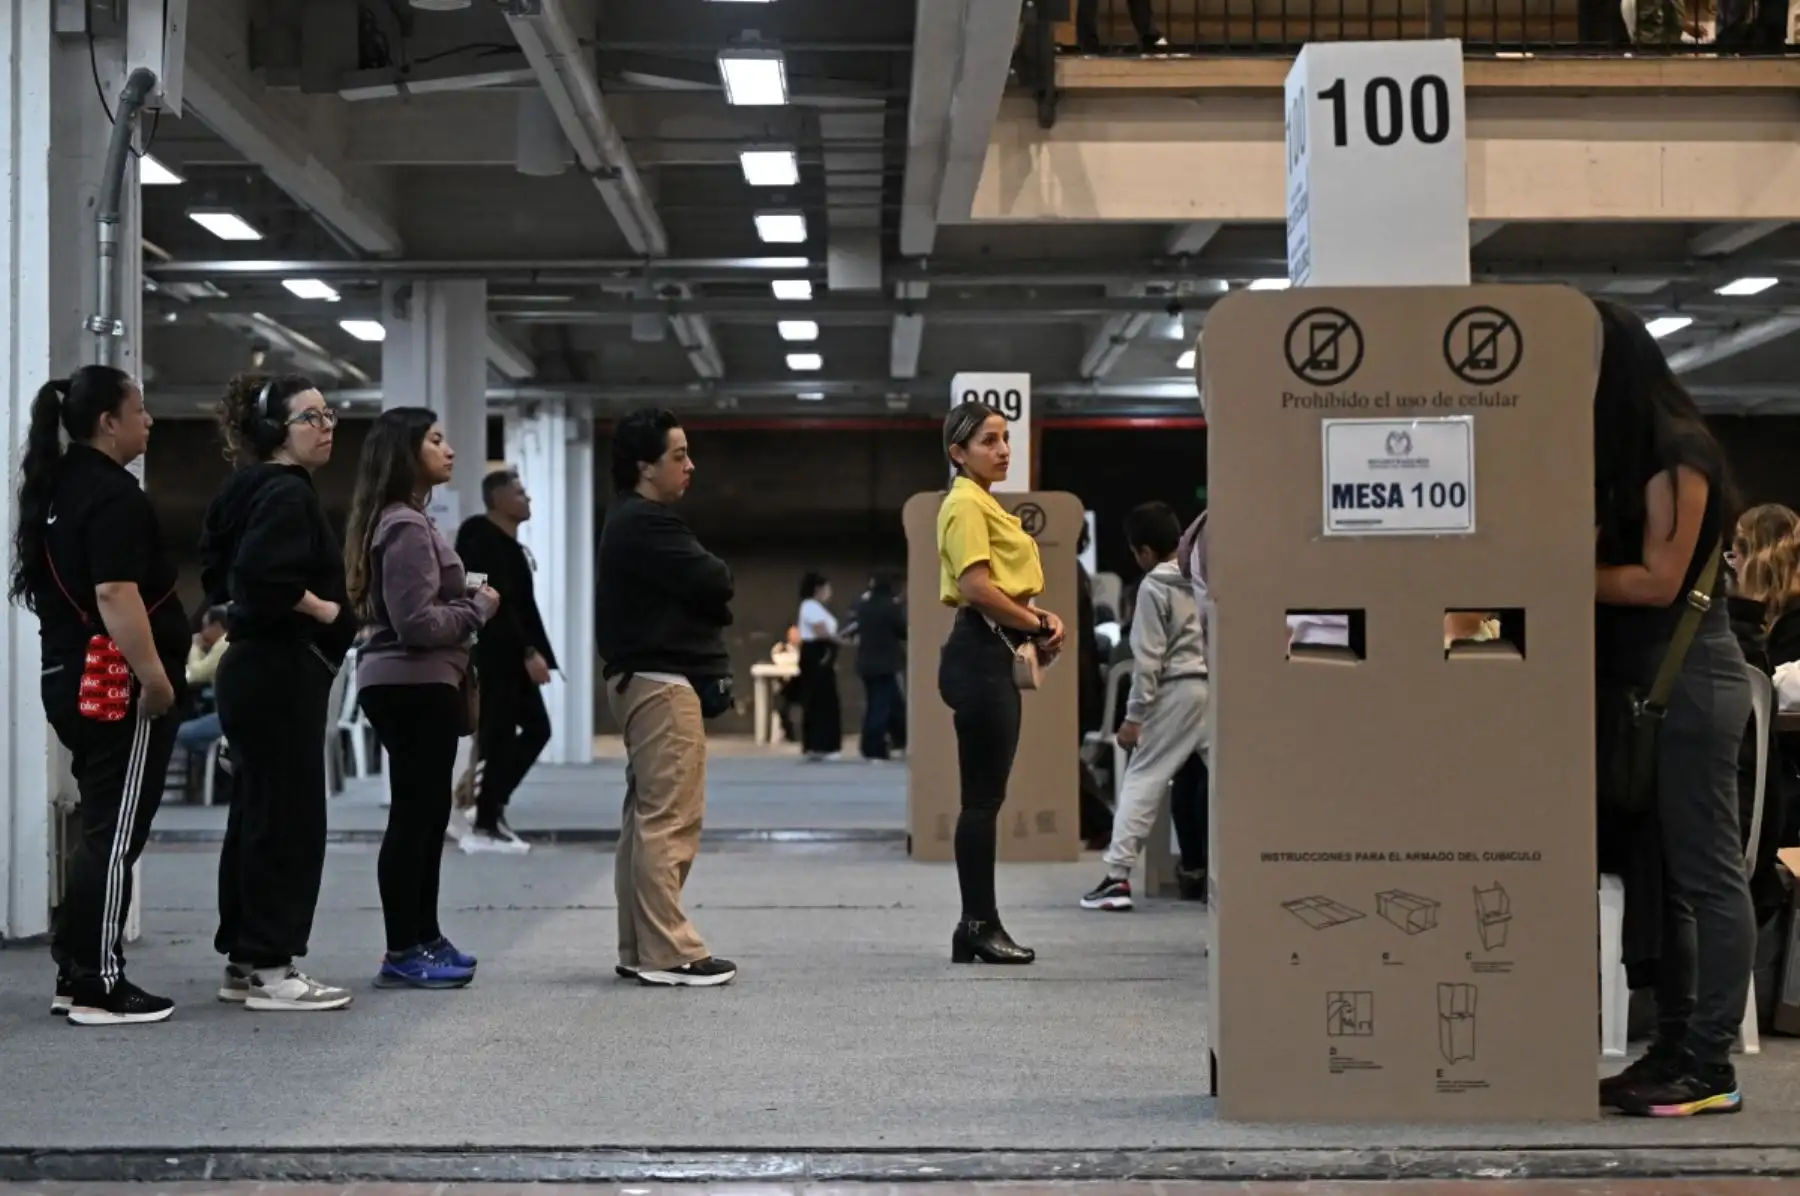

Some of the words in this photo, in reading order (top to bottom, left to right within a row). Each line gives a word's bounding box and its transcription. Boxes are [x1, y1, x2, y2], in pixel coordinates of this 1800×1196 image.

[1317, 74, 1450, 147] 100
[1281, 391, 1369, 409] Prohibido
[1374, 391, 1390, 408] el
[1396, 394, 1427, 408] uso
[1432, 391, 1453, 408] de
[1458, 391, 1519, 408] celular
[1332, 483, 1404, 509] MESA
[1411, 481, 1466, 508] 100
[1260, 851, 1353, 862] INSTRUCCIONES
[1355, 851, 1386, 862] PARA
[1388, 851, 1402, 861] EL
[1405, 851, 1455, 861] ARMADO
[1458, 851, 1479, 862] DEL
